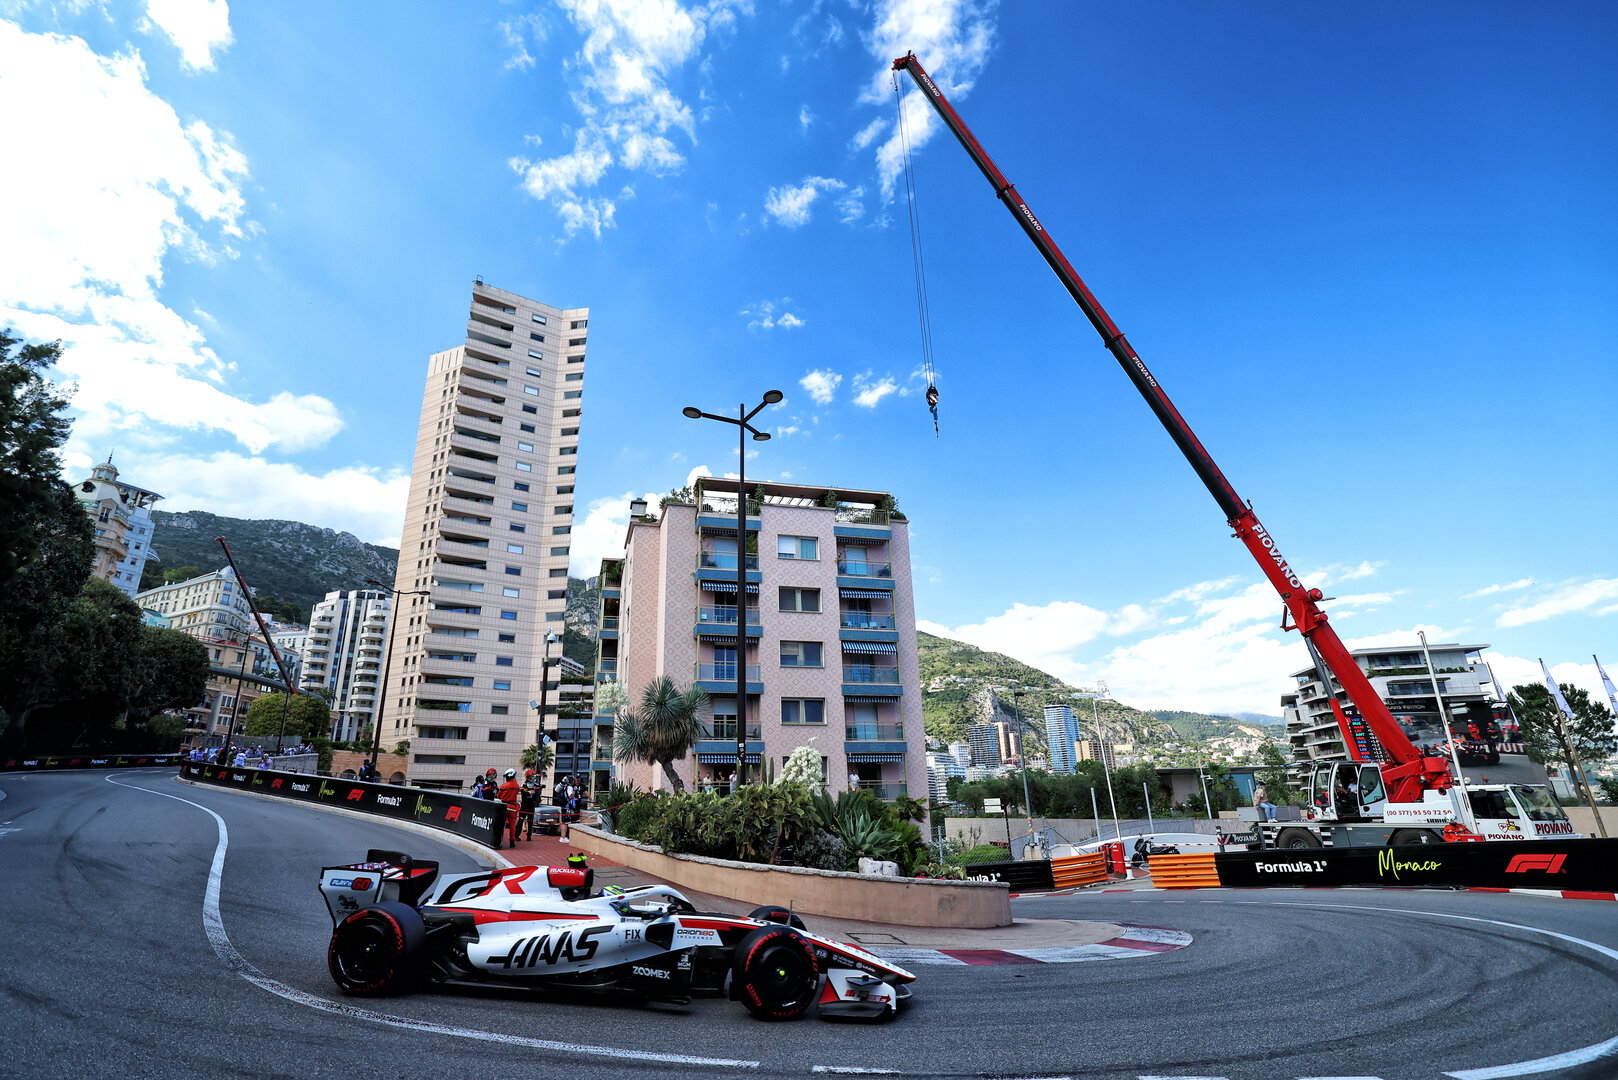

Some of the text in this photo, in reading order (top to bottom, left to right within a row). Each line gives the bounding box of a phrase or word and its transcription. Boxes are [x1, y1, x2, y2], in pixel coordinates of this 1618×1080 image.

[921, 73, 940, 97] PIOVANO
[1020, 204, 1042, 231] PIOVANO
[1132, 356, 1157, 387] PIOVANO
[1251, 523, 1301, 589] PIOVANO
[291, 782, 306, 791] Formula
[347, 789, 364, 801] F1
[377, 794, 396, 806] Formula
[445, 805, 462, 822] F1
[471, 813, 487, 829] Formula
[1534, 823, 1573, 835] PIOVANO
[1232, 834, 1258, 842] PIOVANO
[1255, 860, 1313, 873] Formula
[1378, 848, 1441, 880] Monaco
[1504, 853, 1568, 874] F1
[352, 879, 372, 891] GO
[625, 929, 641, 939] FIX
[486, 925, 615, 969] HAAS
[632, 966, 670, 979] ZOOMEX
